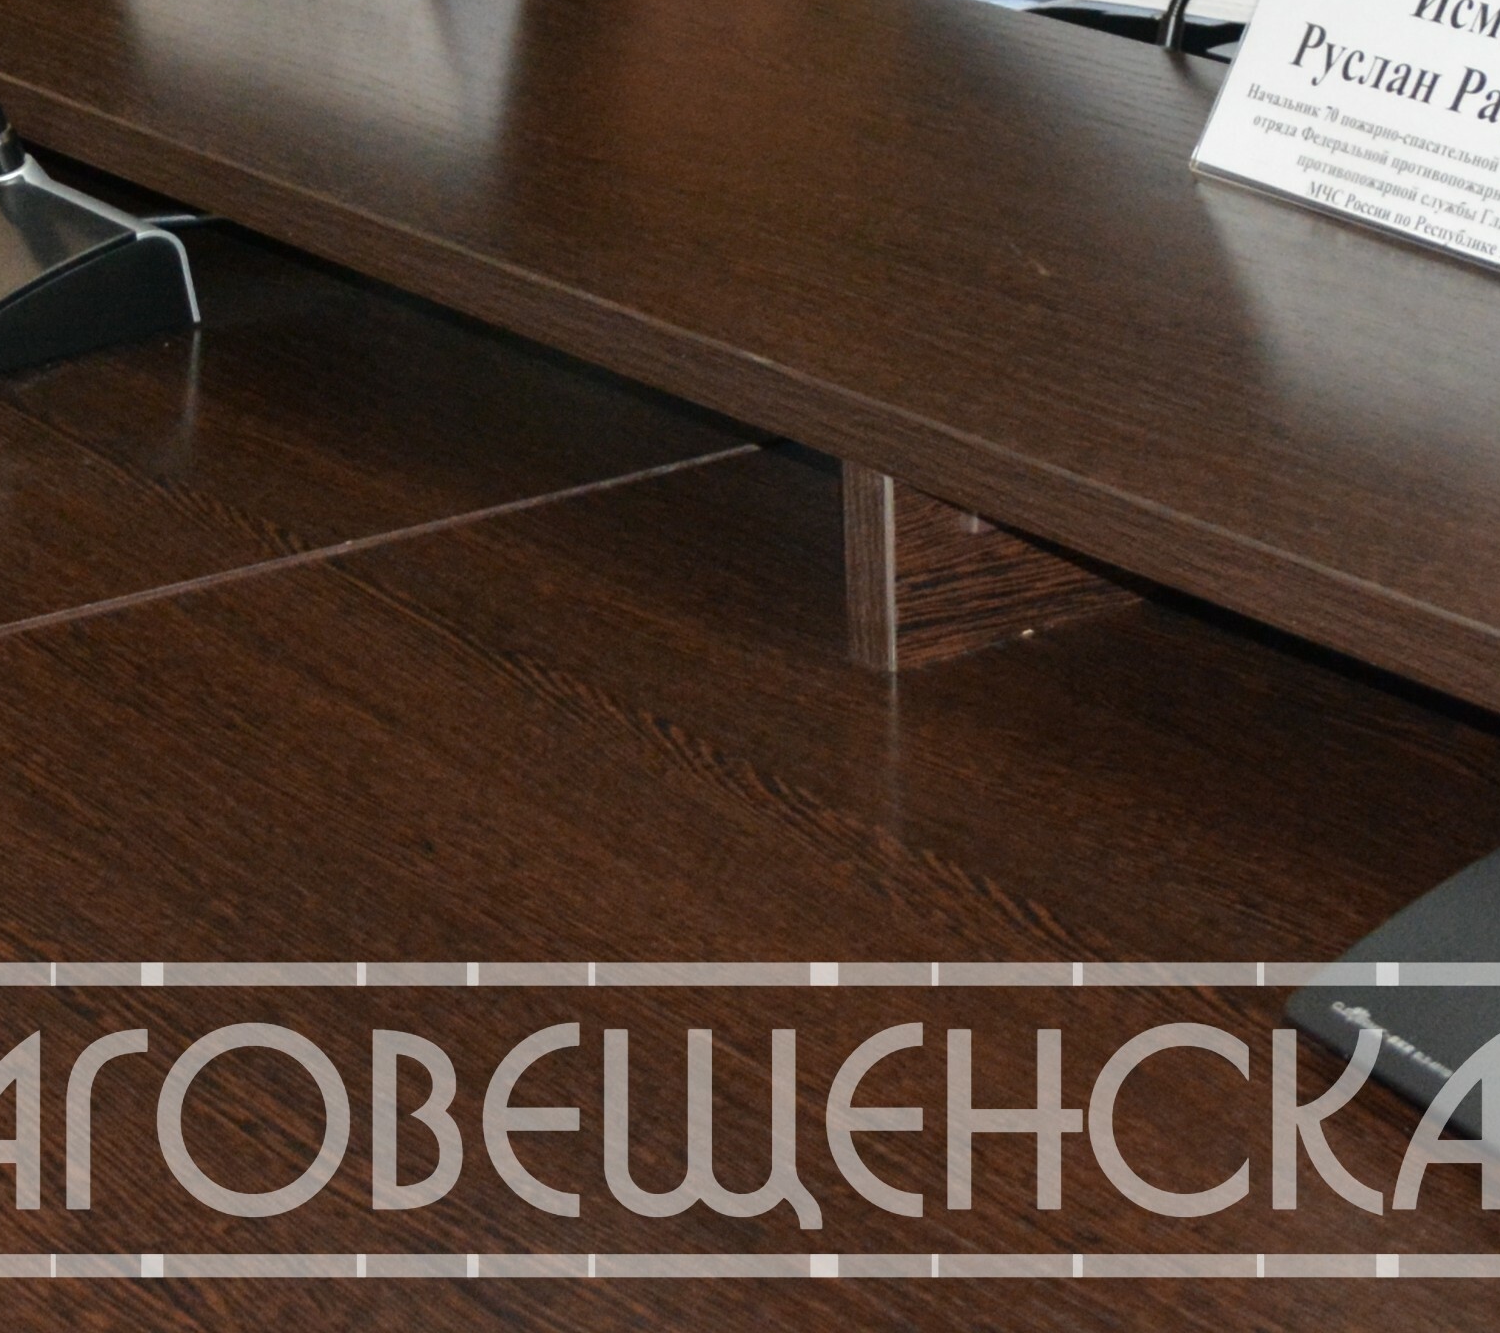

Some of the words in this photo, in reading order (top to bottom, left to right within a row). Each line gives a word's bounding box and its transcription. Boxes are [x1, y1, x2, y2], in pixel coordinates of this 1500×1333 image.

[1289, 20, 1443, 106] Руслан
[1247, 82, 1321, 118] Начальник
[1323, 105, 1340, 123] 70
[1341, 113, 1500, 173] пожарно-спасательной
[1253, 113, 1298, 140] отряда
[1301, 125, 1388, 167] Федеральной
[1296, 153, 1418, 202] противопожарной
[1420, 193, 1477, 222] службы
[1307, 180, 1344, 206] МЧС
[1344, 191, 1391, 221] России
[1393, 209, 1411, 227] по
[1413, 212, 1498, 256] Республике
